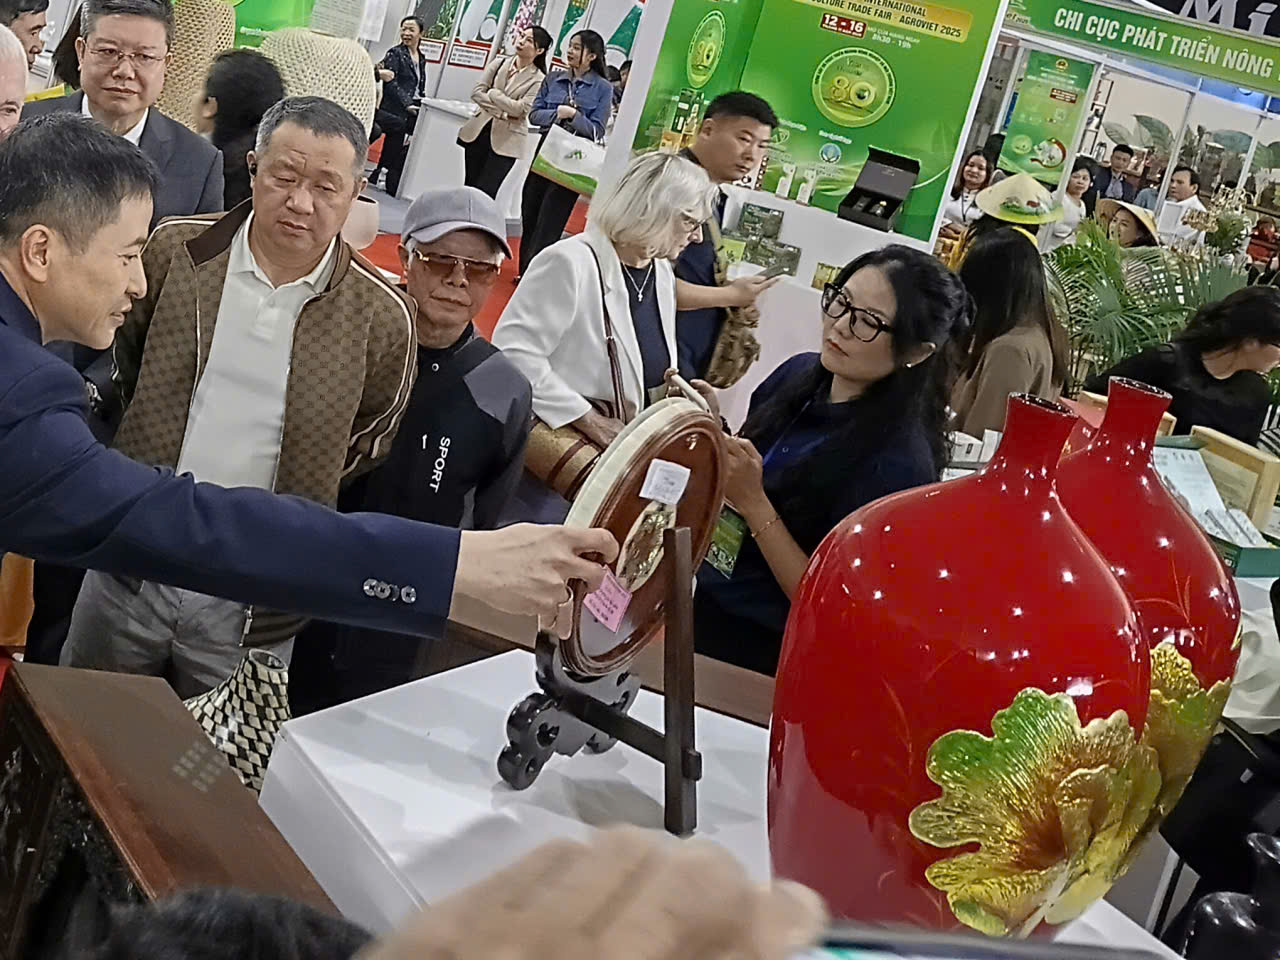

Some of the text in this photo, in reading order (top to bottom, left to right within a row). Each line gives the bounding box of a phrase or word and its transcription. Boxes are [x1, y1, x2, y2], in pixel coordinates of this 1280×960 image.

[823, 15, 838, 26] 12
[849, 21, 864, 32] 16
[847, 2, 872, 16] TRADE
[873, 8, 892, 21] FAIR
[899, 15, 939, 32] AGROVIET
[939, 24, 961, 38] 2025
[1054, 8, 1274, 79] CHI CỤC PHÁT TRIỂN NÔNG
[429, 436, 451, 493] SPORT
